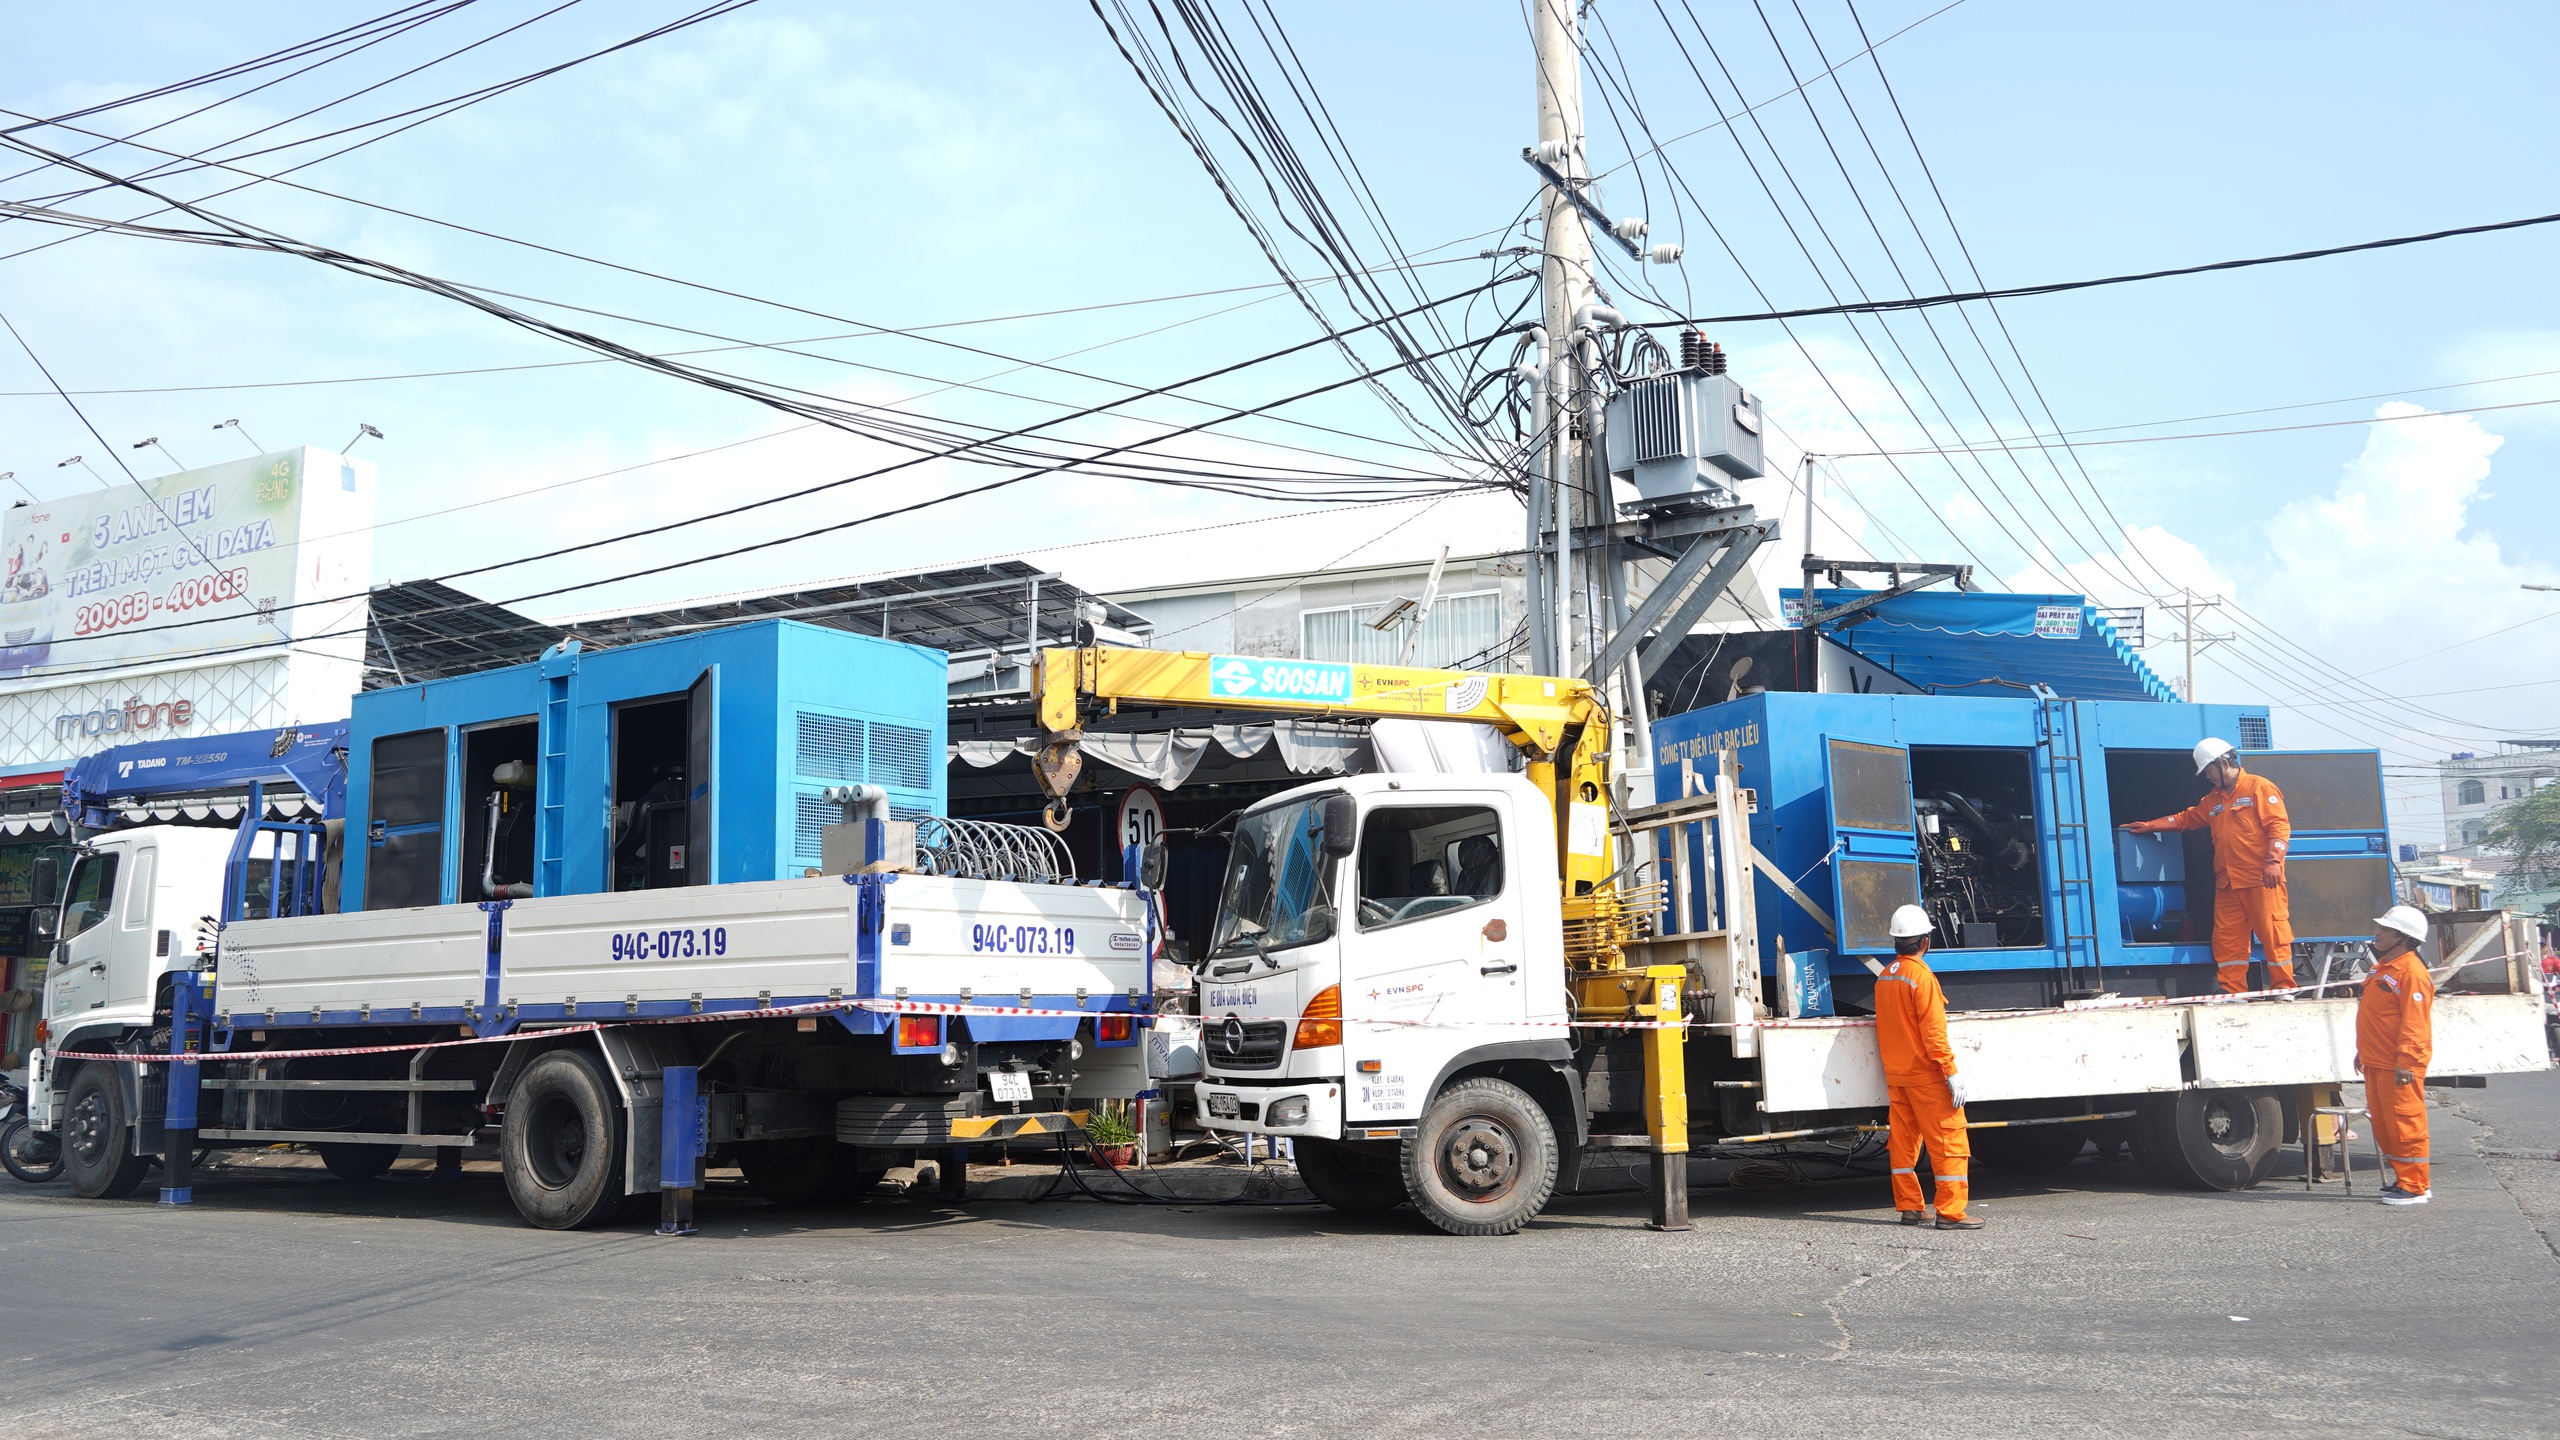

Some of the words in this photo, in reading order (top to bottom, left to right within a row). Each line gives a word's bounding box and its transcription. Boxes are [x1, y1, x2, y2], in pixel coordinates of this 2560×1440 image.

[271, 460, 290, 478] 4G
[93, 515, 111, 549] 5
[112, 498, 171, 546] ANH
[173, 485, 217, 526] EM
[64, 559, 120, 598] TRÊN
[120, 548, 169, 585] MỘT
[171, 531, 214, 571] GÓI
[215, 518, 276, 561] DATA
[74, 591, 149, 636] 200GB
[165, 567, 249, 613] 400GB
[1260, 666, 1346, 697] SOOSAN
[1376, 678, 1410, 687] EVNSPC
[55, 695, 195, 741] mobifone
[1660, 741, 1679, 766] CÔNG
[1679, 740, 1688, 759] TY
[1690, 733, 1707, 761] ĐIỆN
[1708, 730, 1723, 757] LỰC
[1741, 719, 1759, 747] LIÊU
[137, 757, 167, 769] TADANO
[1128, 808, 1156, 845] 50
[612, 927, 726, 961] 94C-073.19
[973, 924, 1074, 955] 94C-073.19
[1210, 990, 1216, 1007] XE
[1387, 983, 1424, 995] EVNSPC
[1803, 962, 1820, 1011] AQUAFINA
[998, 1087, 1028, 1099] 073.19
[1002, 1073, 1019, 1086] 94C
